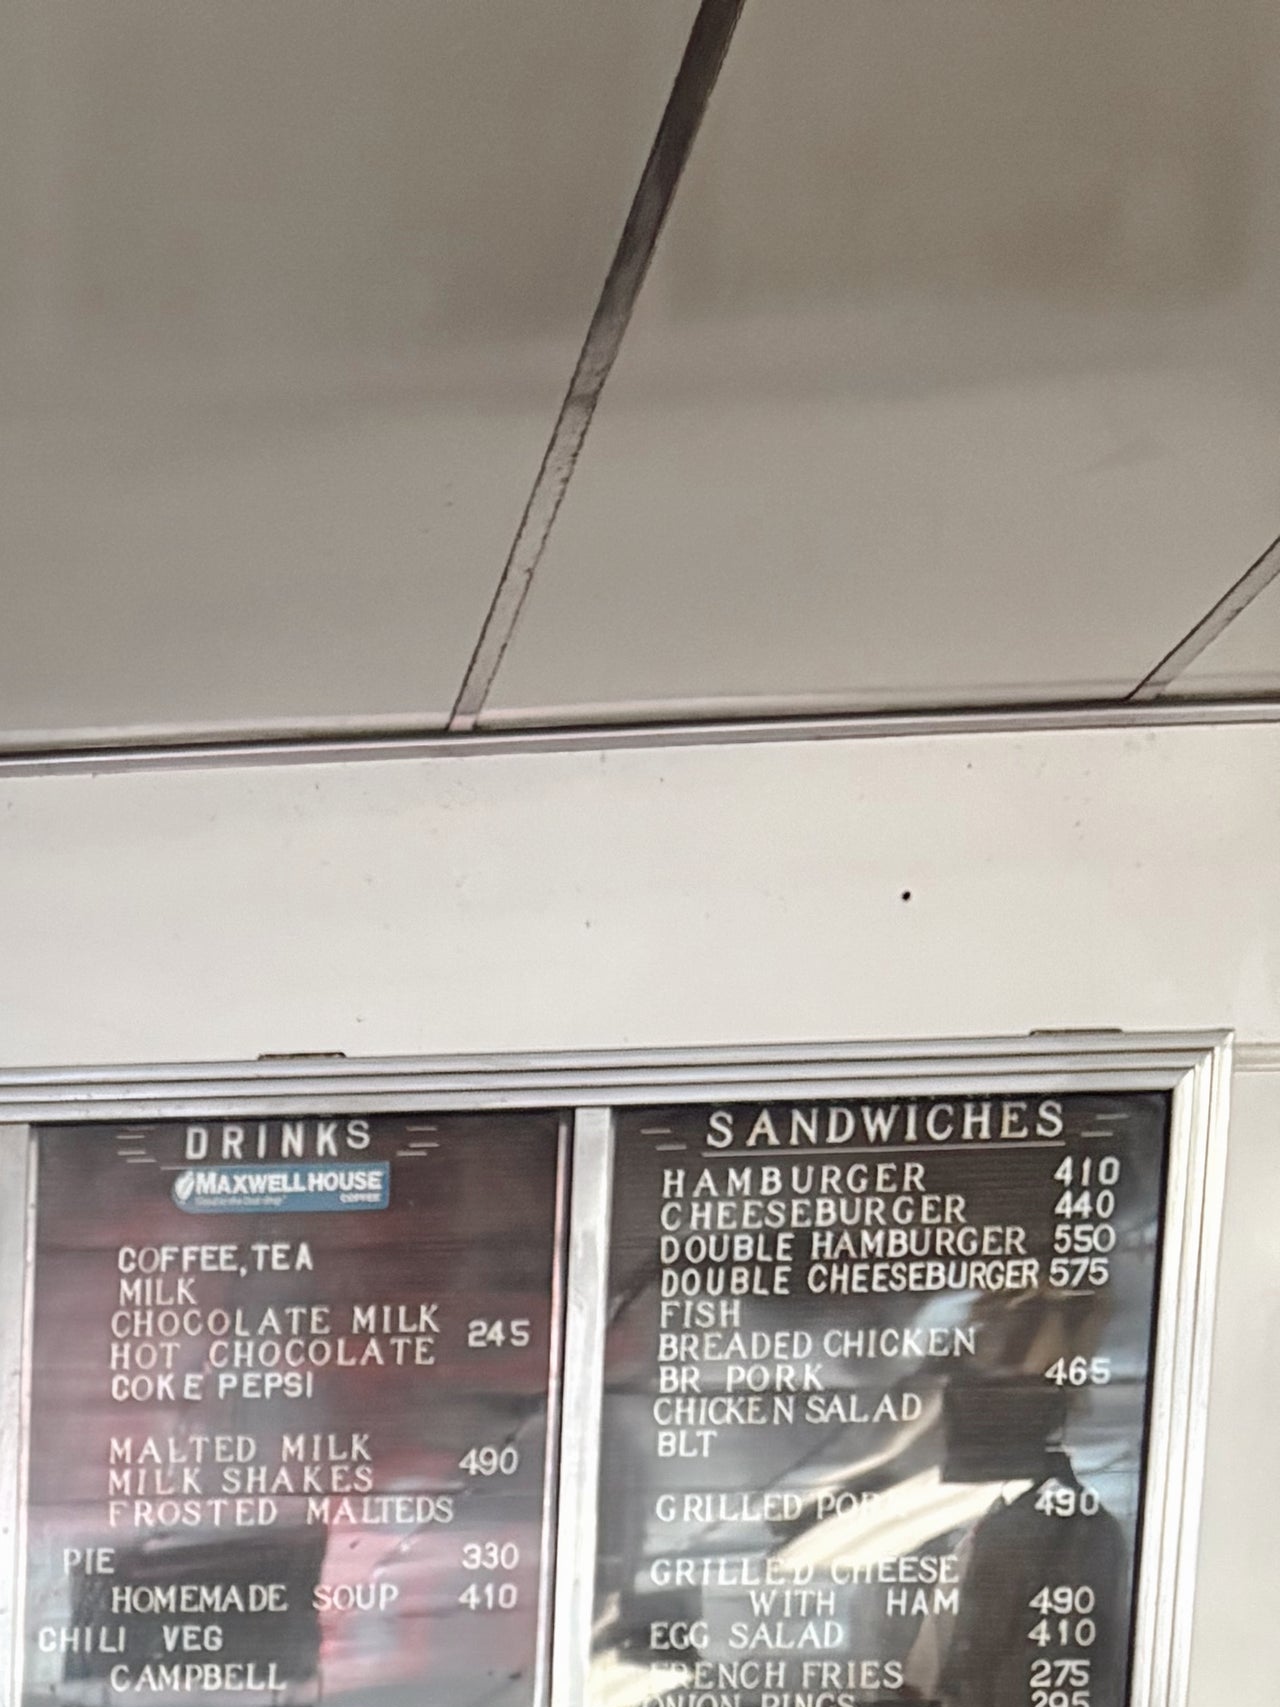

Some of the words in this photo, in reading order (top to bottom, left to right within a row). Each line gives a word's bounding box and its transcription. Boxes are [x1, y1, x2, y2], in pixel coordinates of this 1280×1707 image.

[185, 1120, 370, 1160] DRINKS
[707, 1101, 1064, 1149] SANDWICHES
[195, 1171, 306, 1195] MAXWELL
[307, 1170, 383, 1192] HOUSE
[662, 1162, 926, 1198] HAMBURGER
[1053, 1156, 1119, 1186] 410
[660, 1196, 966, 1232] CHEESEBURGER
[1054, 1191, 1115, 1218] 440
[660, 1232, 794, 1264] DOUBLE
[811, 1226, 1027, 1258] HAMBURGER
[1053, 1226, 1116, 1254] 550
[119, 1278, 197, 1305] MILK
[660, 1265, 791, 1298] DOUBLE
[808, 1258, 1039, 1294] CHEESEBURGER
[1048, 1257, 1109, 1288] 575
[111, 1307, 332, 1339] CHOCOLATE
[352, 1304, 440, 1334] MILK
[468, 1319, 531, 1348] 245
[660, 1299, 741, 1329] FISH
[110, 1343, 182, 1370] HOT
[208, 1338, 436, 1369] CHOCOLATE
[657, 1330, 812, 1362] BREADED
[823, 1326, 976, 1358] CHICKEN
[111, 1374, 203, 1403] COKE
[218, 1372, 313, 1400] PEPSI
[658, 1364, 701, 1394] BR
[725, 1362, 824, 1392] PORK
[1044, 1356, 1111, 1386] 465
[653, 1396, 794, 1426] CHICKEN
[804, 1393, 922, 1424] SALAD
[109, 1437, 256, 1466] MALTED
[282, 1434, 372, 1463] MILK
[458, 1448, 518, 1476] 490
[657, 1429, 717, 1458] BLT
[108, 1468, 203, 1496] MILK
[221, 1466, 374, 1494] SHAKES
[108, 1499, 278, 1528] FROSTED
[306, 1497, 454, 1525] MALTEDS
[655, 1492, 802, 1523] GRILLED
[1034, 1486, 1100, 1517] 490
[63, 1548, 115, 1575] PIE
[462, 1543, 519, 1571] 330
[650, 1556, 814, 1586] GRILLED
[831, 1555, 960, 1584] CHEESE
[111, 1586, 288, 1615] HOMEMADE
[312, 1585, 398, 1611] SOUP
[458, 1585, 518, 1609] 410
[749, 1589, 836, 1619] WITH
[886, 1588, 960, 1616] HAM
[1029, 1586, 1096, 1615] 490
[38, 1627, 127, 1653] CHILI
[162, 1625, 222, 1651] VEG
[650, 1622, 709, 1652] EGG
[728, 1620, 844, 1651] SALAD
[1028, 1619, 1097, 1648] 410
[110, 1663, 286, 1693] CAMPBELL
[801, 1661, 904, 1691] FRIES
[1031, 1659, 1090, 1687] 275
